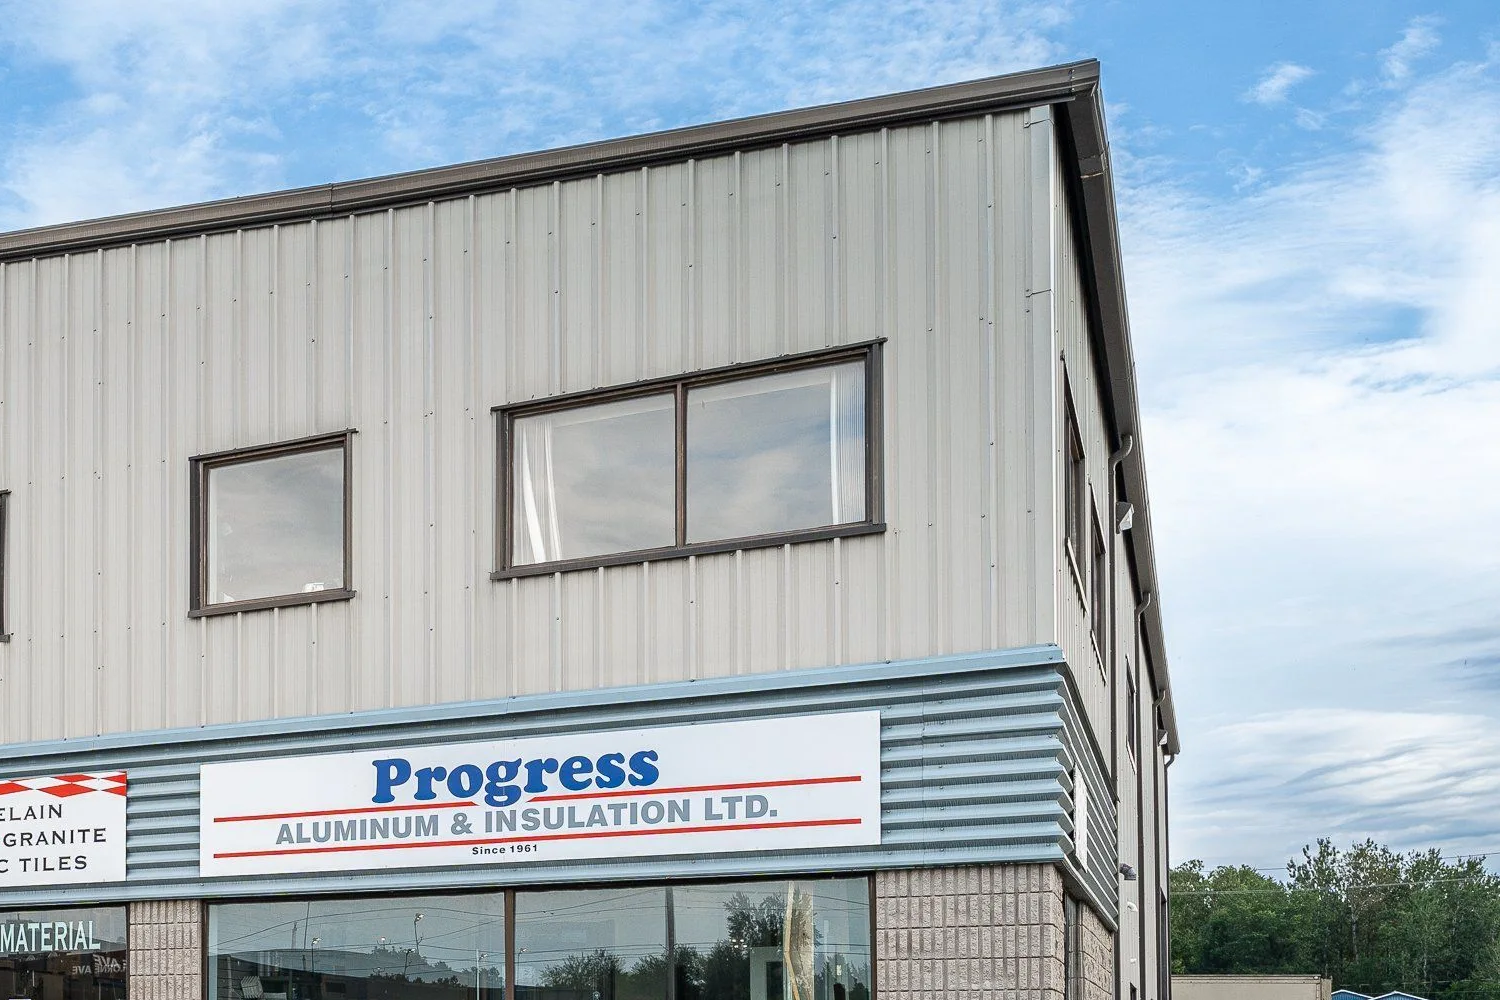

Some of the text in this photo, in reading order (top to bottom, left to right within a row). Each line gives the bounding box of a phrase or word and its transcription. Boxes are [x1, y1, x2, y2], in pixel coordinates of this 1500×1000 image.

[371, 750, 659, 808] Progress
[275, 794, 778, 845] ALUMINUM & INSULATION LTD.
[2, 827, 107, 847] GRANITE
[472, 844, 538, 855] Since 1961
[18, 855, 88, 872] TILES
[0, 920, 101, 953] MATERIAL
